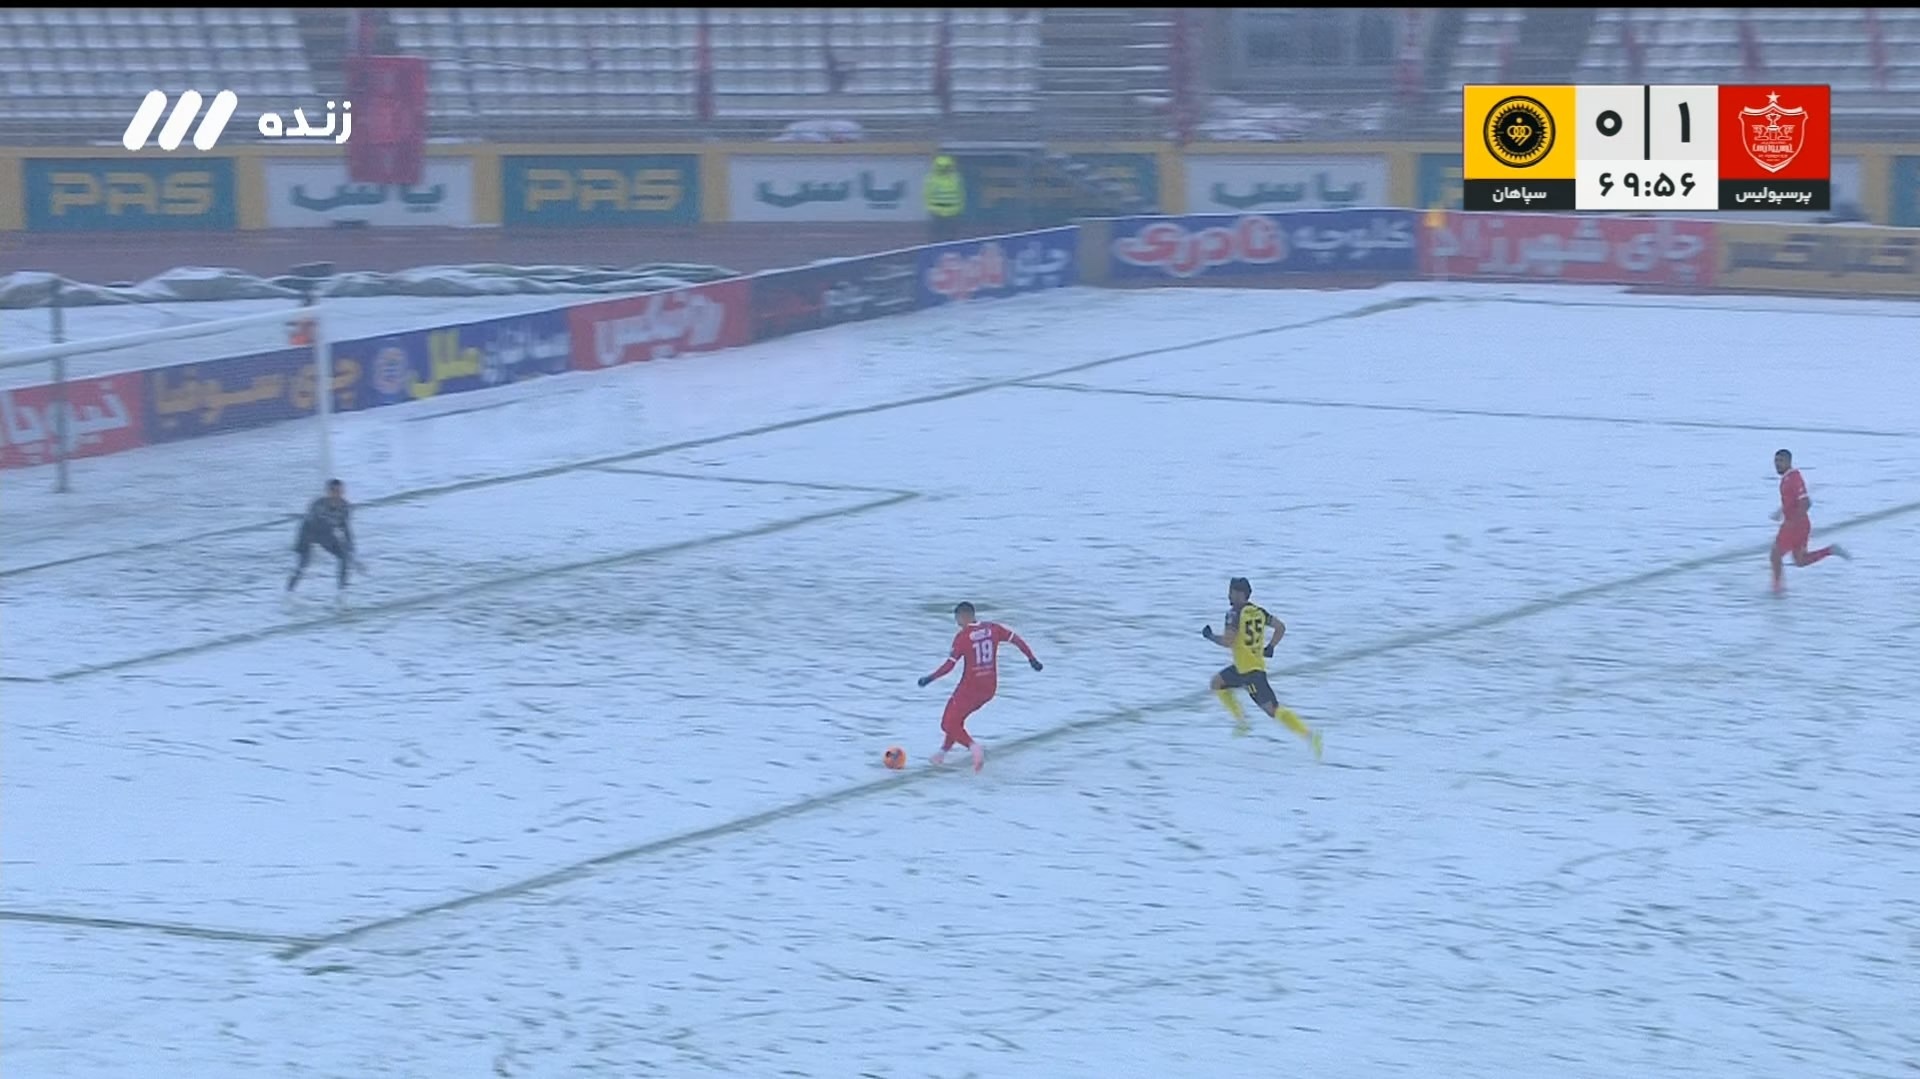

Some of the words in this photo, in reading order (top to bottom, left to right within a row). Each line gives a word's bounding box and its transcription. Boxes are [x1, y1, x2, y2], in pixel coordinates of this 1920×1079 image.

[49, 171, 214, 216] PAS
[522, 168, 683, 212] PAS
[755, 170, 910, 209] یاس
[1209, 172, 1362, 209] یاس
[1113, 215, 1288, 278] نادری
[1293, 217, 1414, 263] کلوچه
[1615, 219, 1704, 281] چای
[1244, 618, 1263, 647] 55
